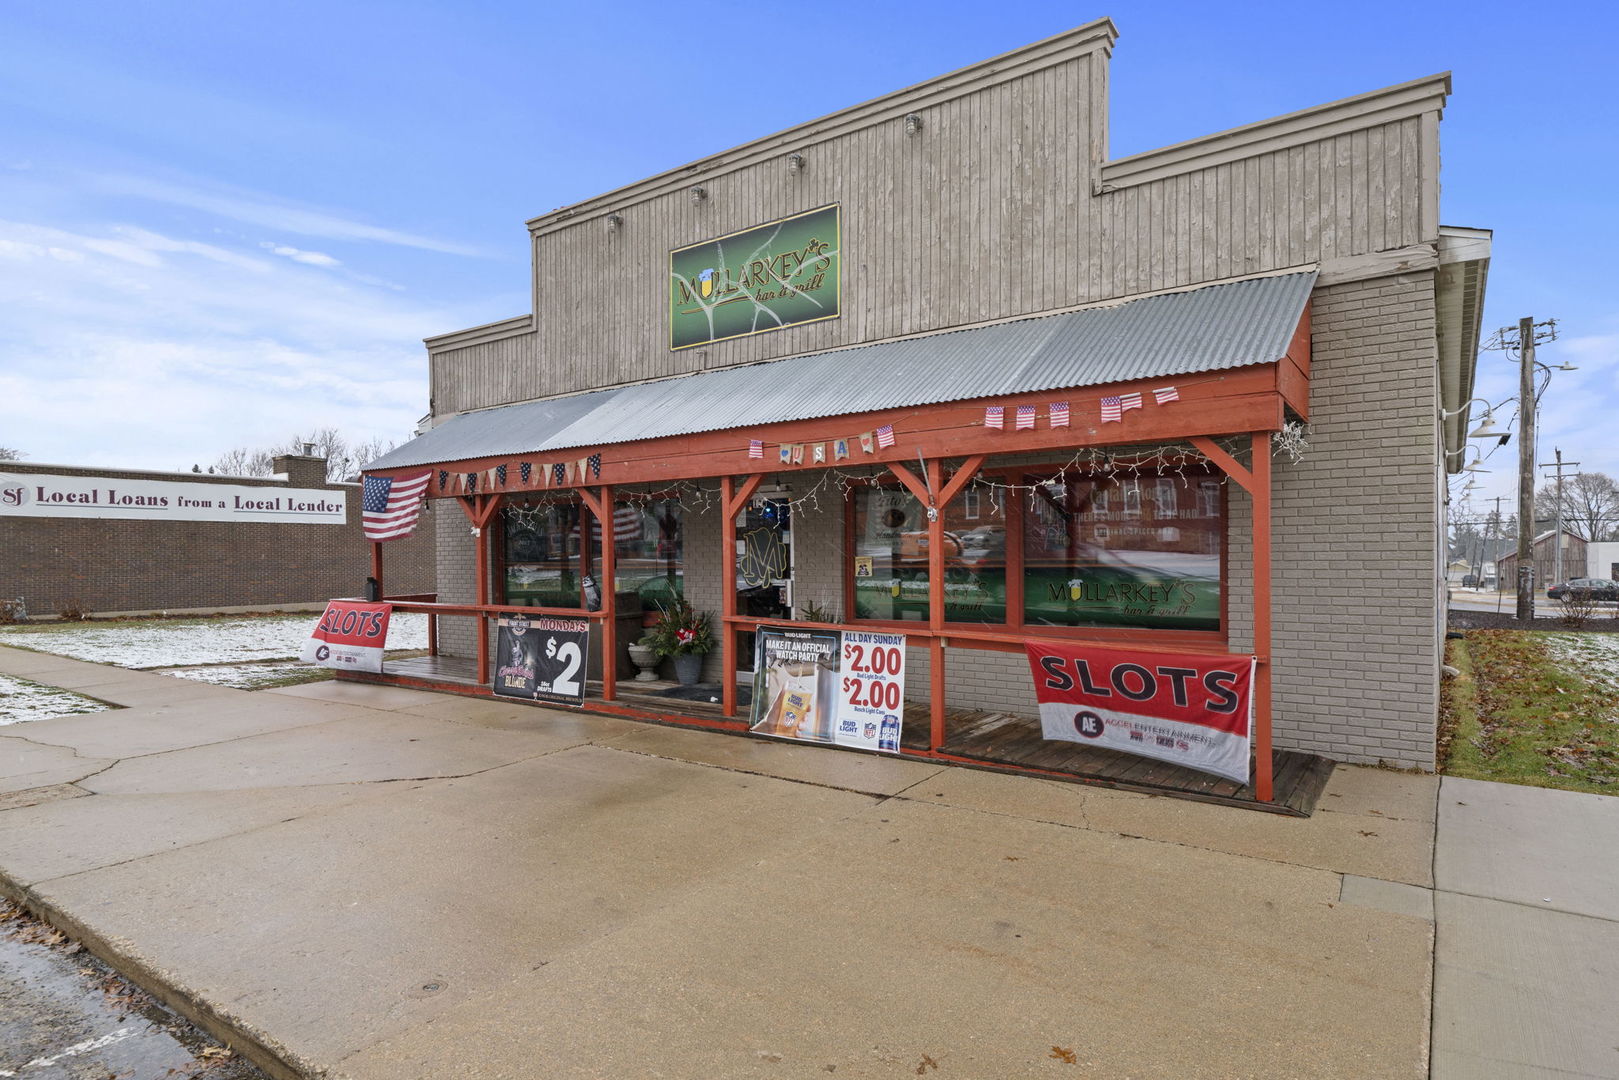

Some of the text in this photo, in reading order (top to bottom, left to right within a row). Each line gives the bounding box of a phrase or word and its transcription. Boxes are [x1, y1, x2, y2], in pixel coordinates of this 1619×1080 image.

[754, 287, 776, 302] bar
[790, 272, 824, 297] grill
[36, 486, 343, 513] Local Loans from a Local Lender
[1049, 578, 1196, 606] MULLARKEY'S
[1124, 604, 1143, 616] bar
[319, 608, 384, 638] SLOTS
[540, 619, 586, 632] MONDAYS
[766, 640, 830, 654] MAKE IT AN OFFICIAL
[844, 633, 902, 645] ALL DAY SUNDAY
[545, 636, 581, 696] $2
[776, 650, 820, 662] WATCH PARTY
[844, 642, 901, 676] $2.00
[843, 676, 900, 710] $2.00
[1039, 656, 1239, 715] SLOTS
[865, 707, 875, 715] Light
[839, 725, 858, 734] LIGHT
[1082, 716, 1097, 734] AE
